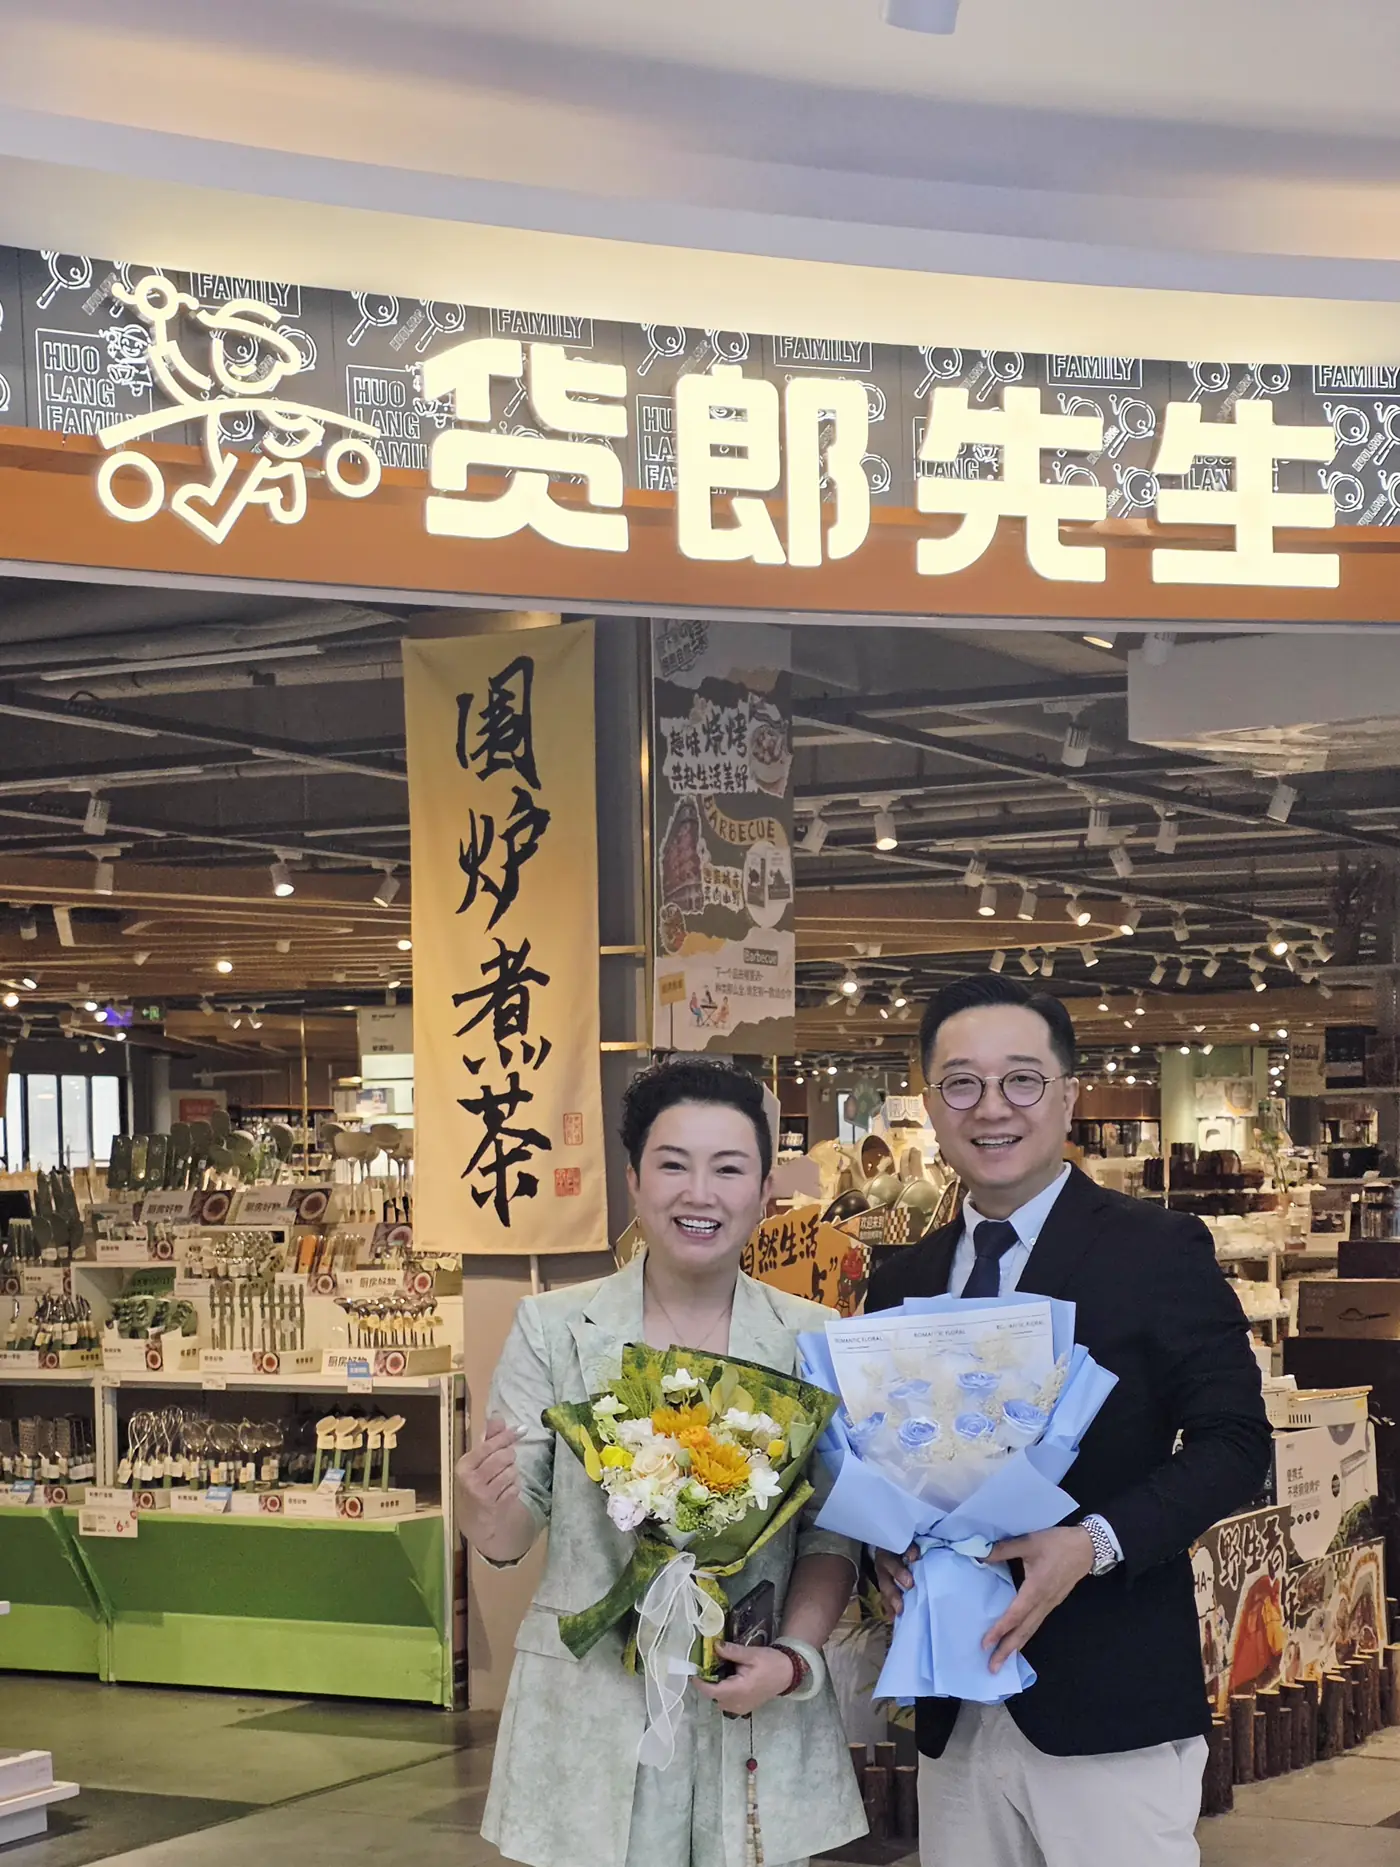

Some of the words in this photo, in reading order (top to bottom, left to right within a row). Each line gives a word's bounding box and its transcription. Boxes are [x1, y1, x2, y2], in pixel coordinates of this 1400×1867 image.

[198, 272, 291, 307] FAMILY
[497, 309, 584, 339] FAMILY
[43, 341, 100, 374] HUO
[780, 337, 865, 363] FAMILY
[1053, 354, 1135, 381] FAMILY
[1319, 365, 1400, 389] FAMILY
[45, 373, 115, 407] LANG
[353, 377, 406, 408] HUO
[643, 406, 674, 434] HU
[421, 337, 1340, 588] 货郎先生
[703, 796, 775, 843] BARBECUE
